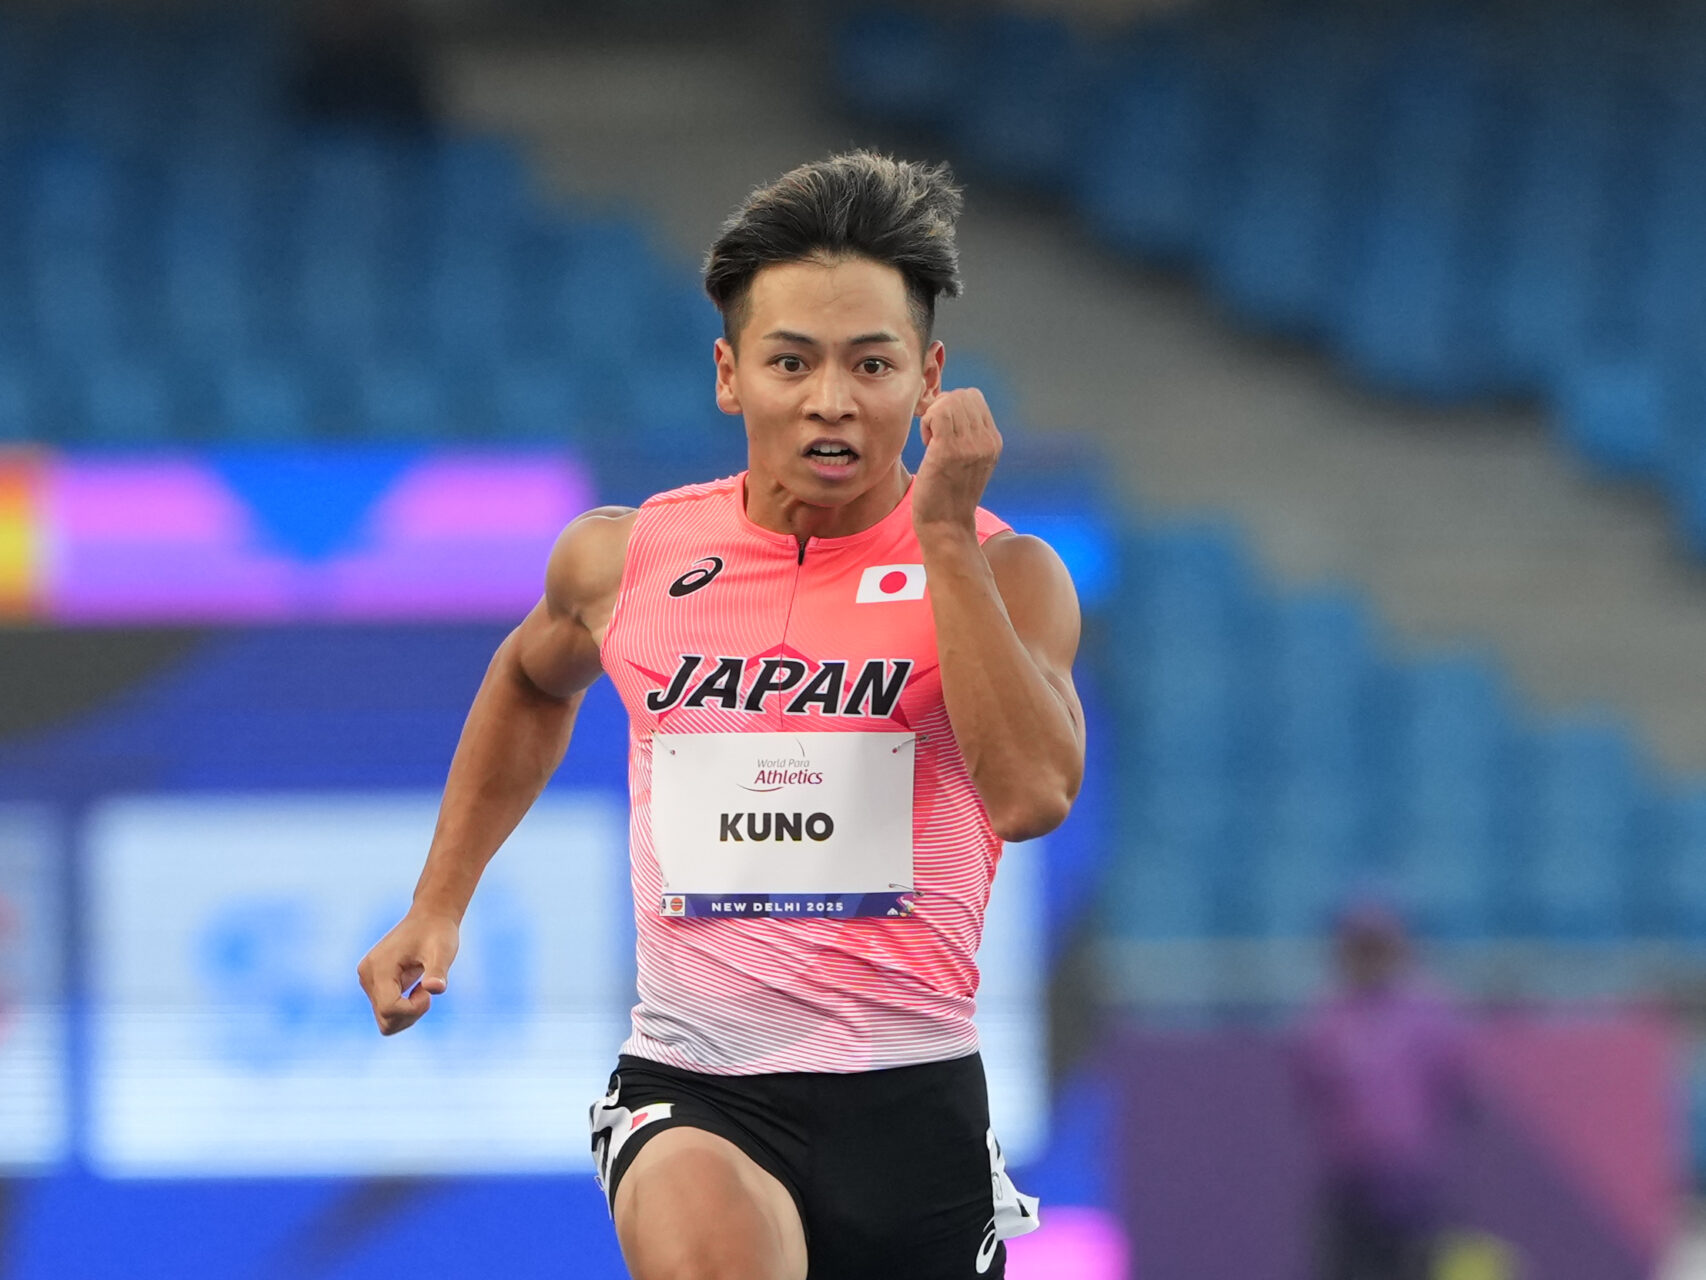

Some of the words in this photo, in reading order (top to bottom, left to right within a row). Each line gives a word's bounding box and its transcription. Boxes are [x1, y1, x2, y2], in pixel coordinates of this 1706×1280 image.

[646, 654, 914, 718] JAPAN
[757, 757, 786, 769] World
[788, 757, 810, 769] Para
[754, 768, 824, 785] Athletics
[719, 812, 835, 842] KUNO
[711, 902, 747, 912] NEW
[753, 902, 801, 912] DELHI
[806, 902, 844, 912] 2025
